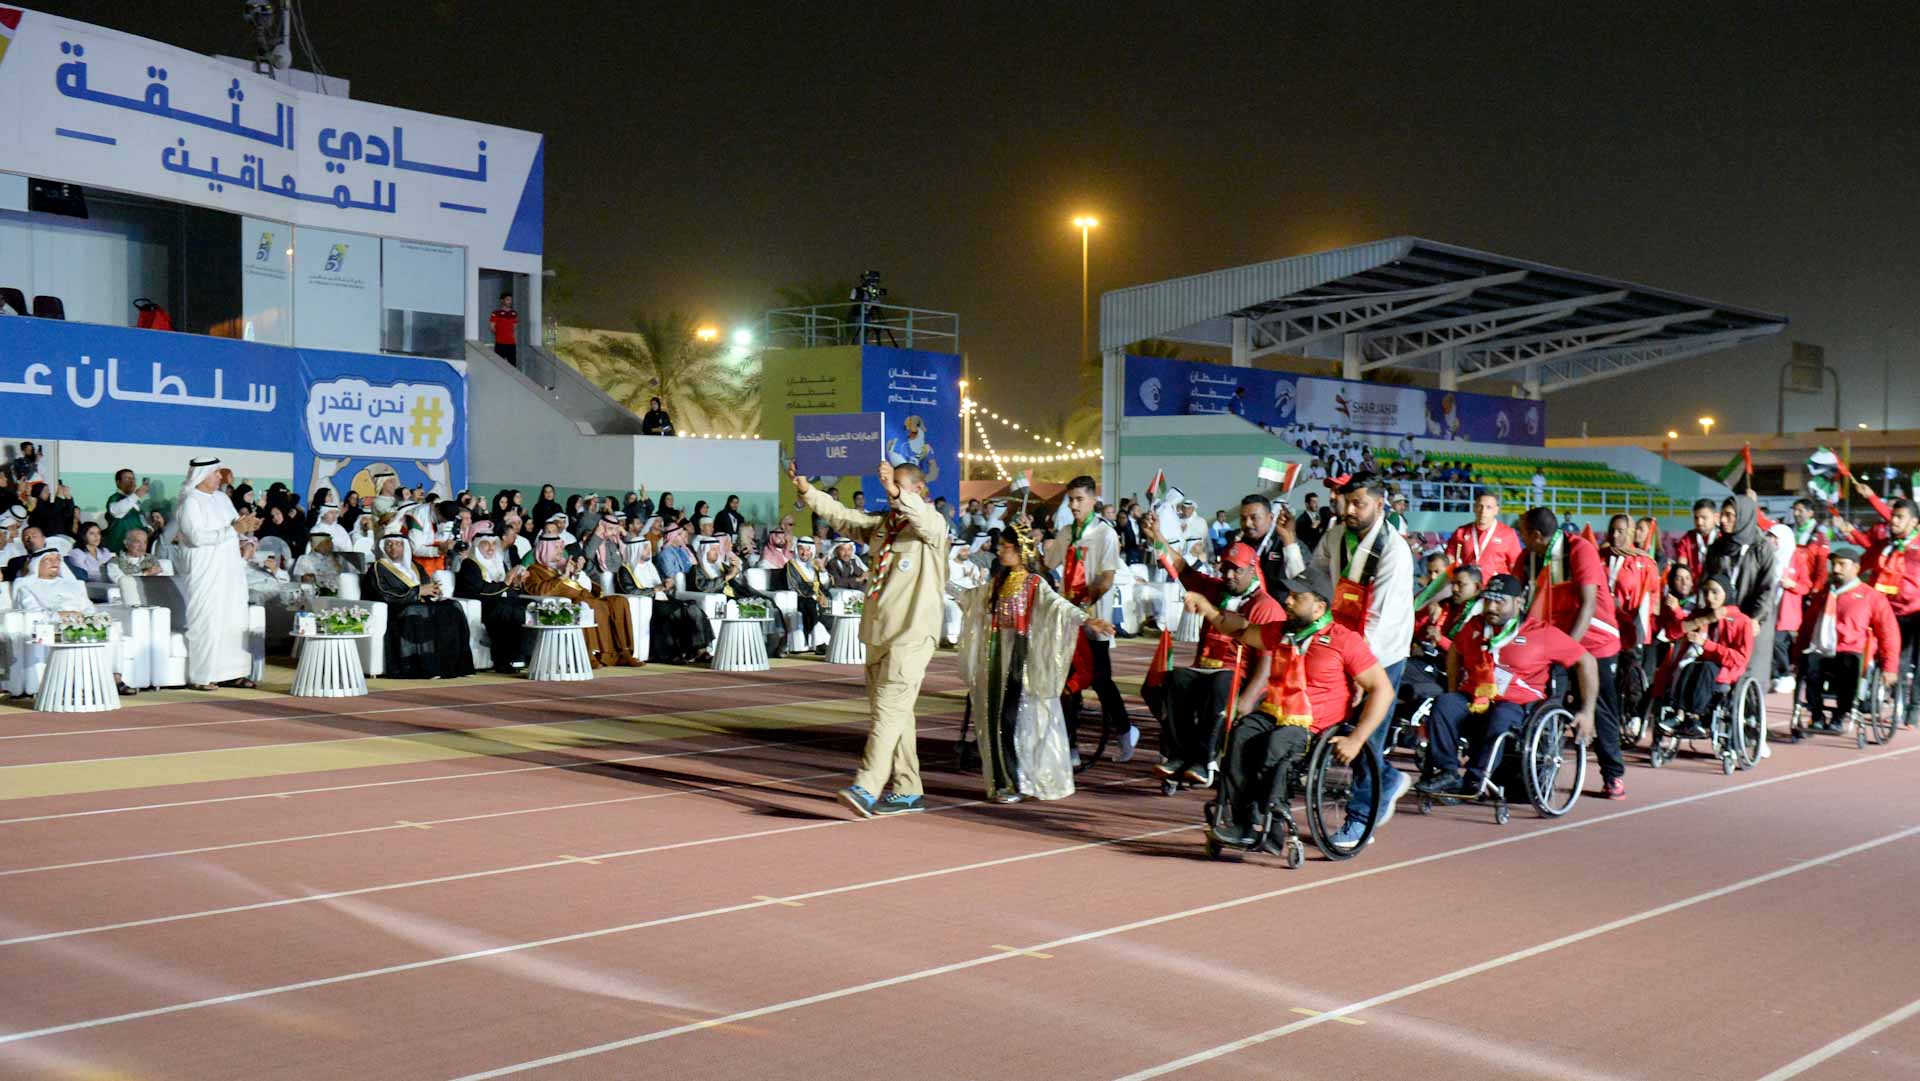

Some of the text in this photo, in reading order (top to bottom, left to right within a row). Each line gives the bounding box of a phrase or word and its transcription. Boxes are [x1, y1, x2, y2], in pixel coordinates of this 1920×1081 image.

[55, 41, 488, 182] نادي الثقة
[161, 137, 397, 214] للمعاقين
[66, 355, 277, 412] سلطان
[888, 367, 937, 380] سلطان
[318, 391, 404, 418] نحن نقدر
[888, 393, 937, 405] مستدام
[1352, 401, 1392, 415] SHARJAH
[319, 422, 404, 446] WE CAN
[825, 446, 848, 459] UAE
